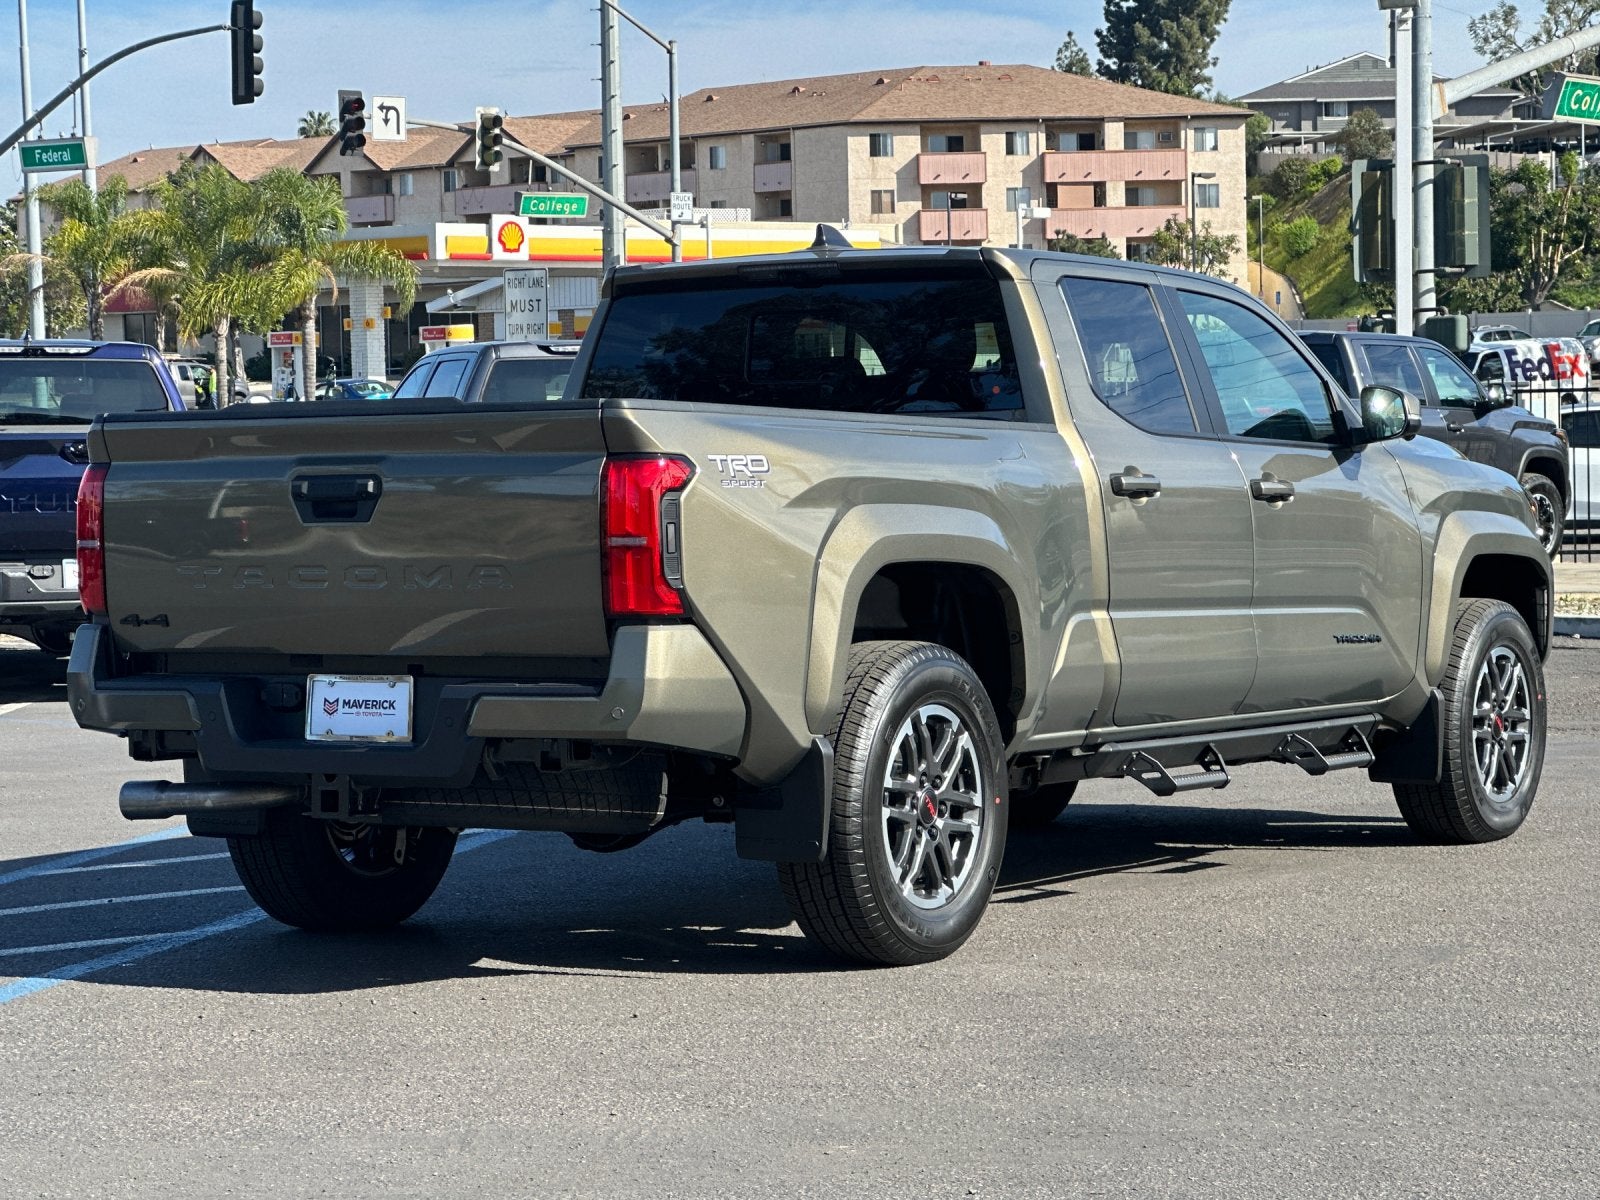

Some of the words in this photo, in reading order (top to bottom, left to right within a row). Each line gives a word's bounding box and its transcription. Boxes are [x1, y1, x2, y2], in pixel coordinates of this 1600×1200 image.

[1571, 89, 1600, 113] Col
[34, 148, 71, 163] Federal
[672, 194, 691, 202] TRUCK
[530, 199, 578, 214] College
[672, 202, 691, 210] ROUTE
[507, 277, 525, 289] RIGHT
[528, 276, 544, 289] LANE
[511, 299, 542, 313] MUST
[508, 323, 524, 335] TURN
[527, 322, 545, 335] RIGHT
[1504, 343, 1586, 381] FedEx
[707, 454, 770, 478] TRD
[721, 479, 767, 489] SPORT
[175, 564, 514, 590] TACOMA
[342, 698, 396, 711] MAVERICK
